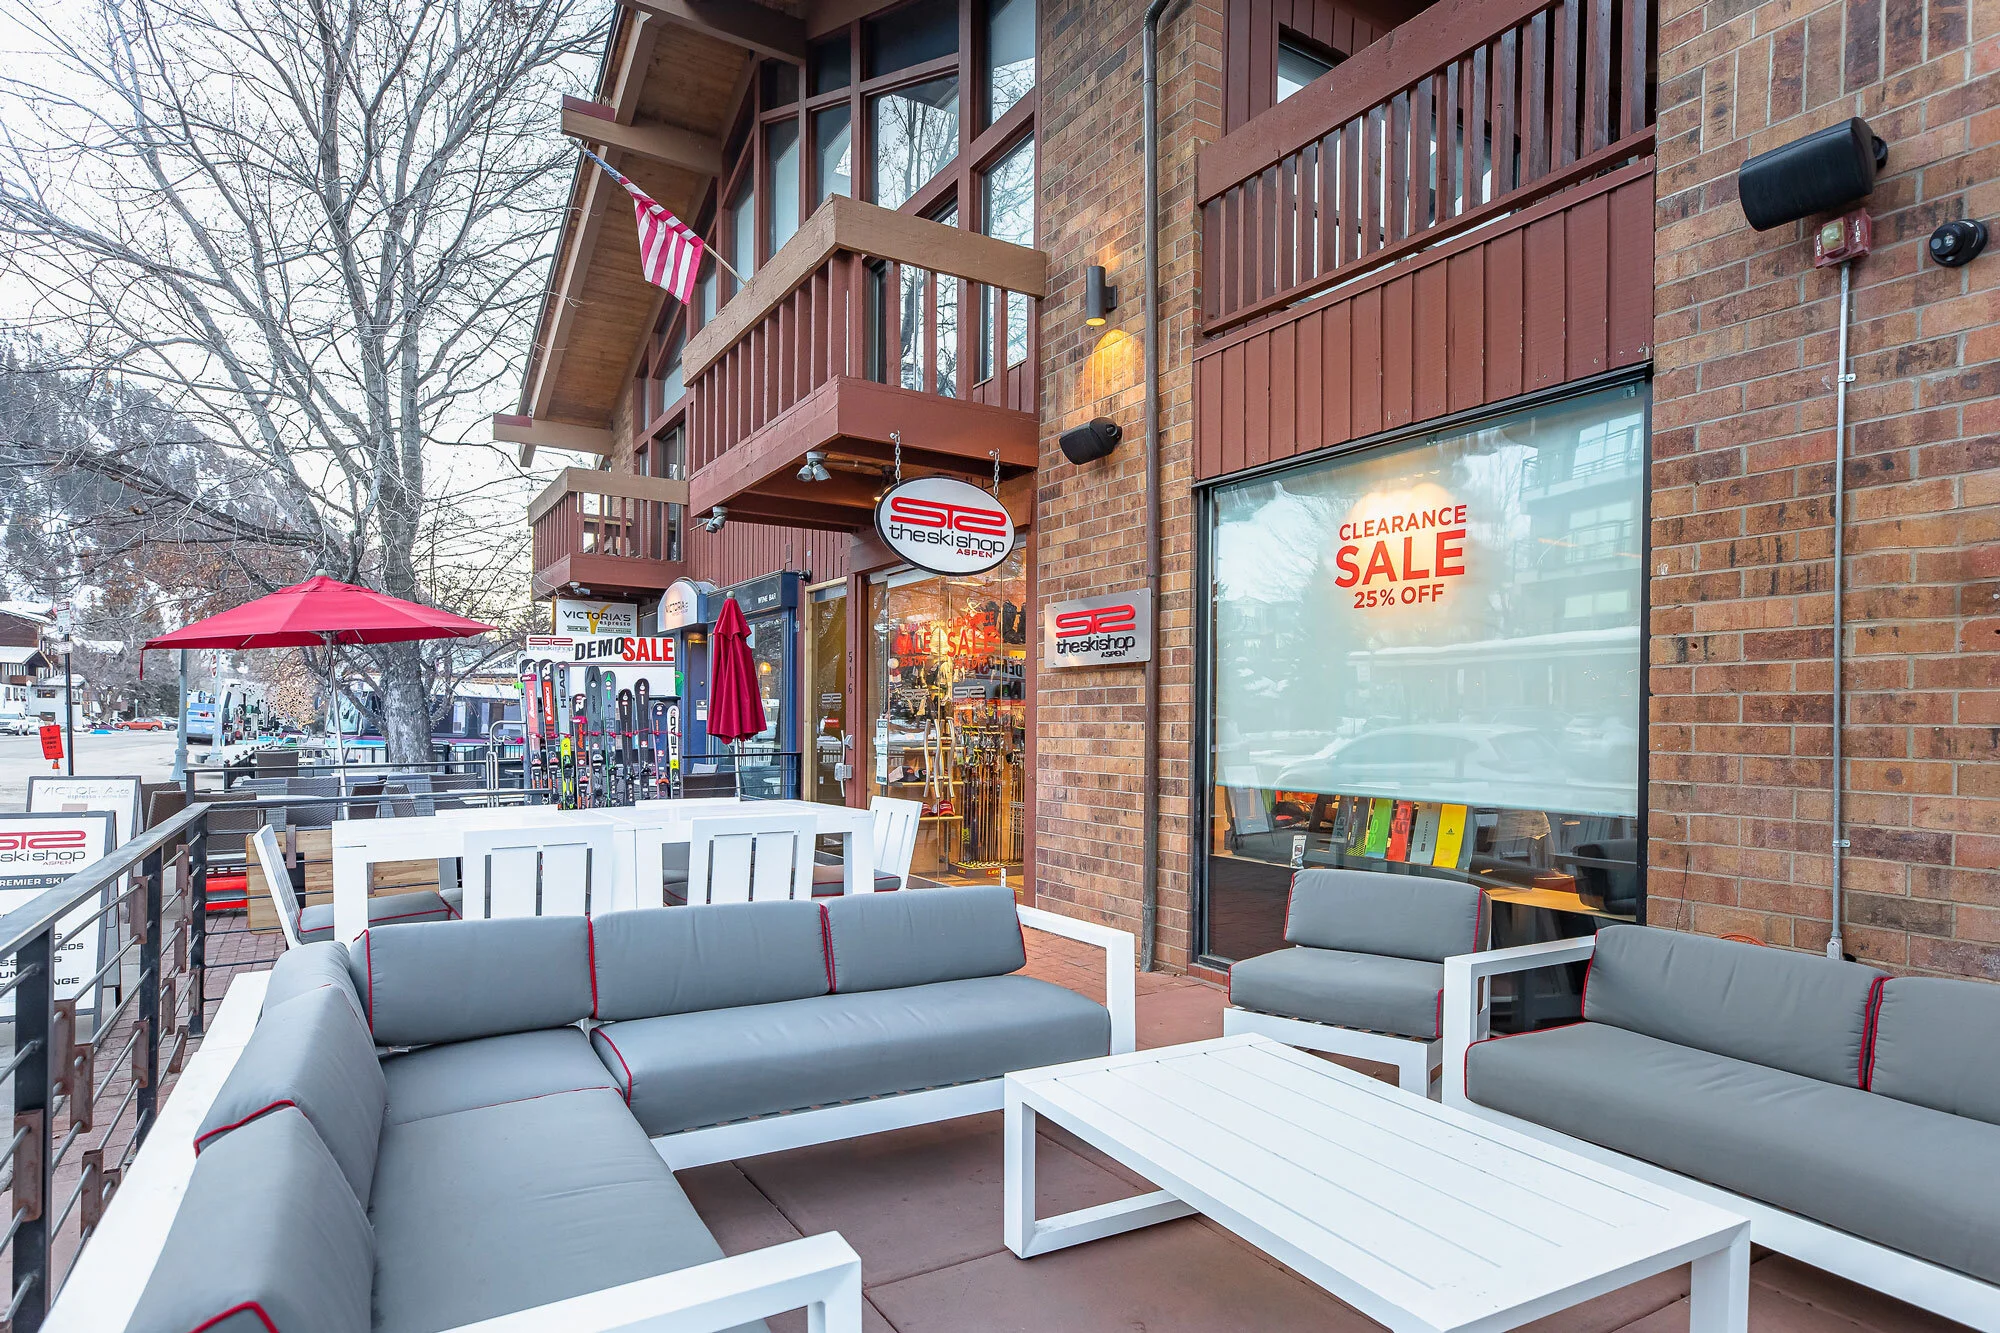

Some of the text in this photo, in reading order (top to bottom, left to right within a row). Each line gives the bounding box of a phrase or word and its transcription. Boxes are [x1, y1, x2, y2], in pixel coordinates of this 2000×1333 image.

[1339, 504, 1467, 541] CLEARANCE
[956, 548, 993, 558] ASPEN
[1335, 529, 1466, 588] SALE
[769, 593, 777, 602] BAR
[1354, 584, 1445, 609] 25% OFF
[563, 610, 631, 622] VICTORIA'S
[575, 637, 674, 661] DEMO SALE
[947, 625, 996, 657] SALE
[1101, 650, 1125, 658] ASPEN
[0, 878, 41, 887] REMIER
